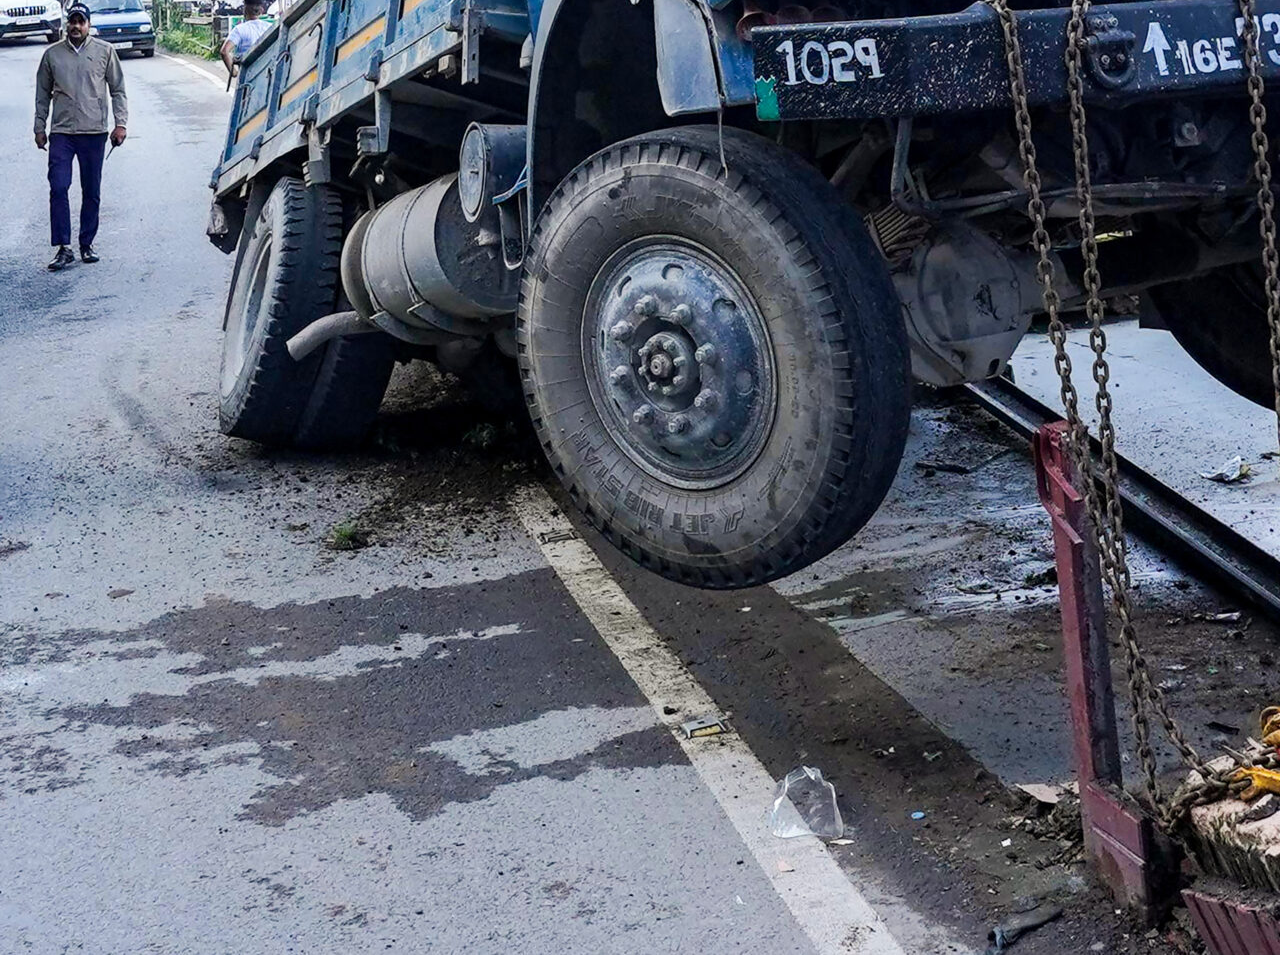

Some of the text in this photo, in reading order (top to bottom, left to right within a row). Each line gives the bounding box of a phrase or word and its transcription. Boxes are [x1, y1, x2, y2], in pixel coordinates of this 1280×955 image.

[775, 38, 886, 86] 1029
[1175, 36, 1244, 75] 16E
[571, 430, 625, 497] STAR
[622, 489, 666, 528] RIB
[669, 511, 716, 535] JET
